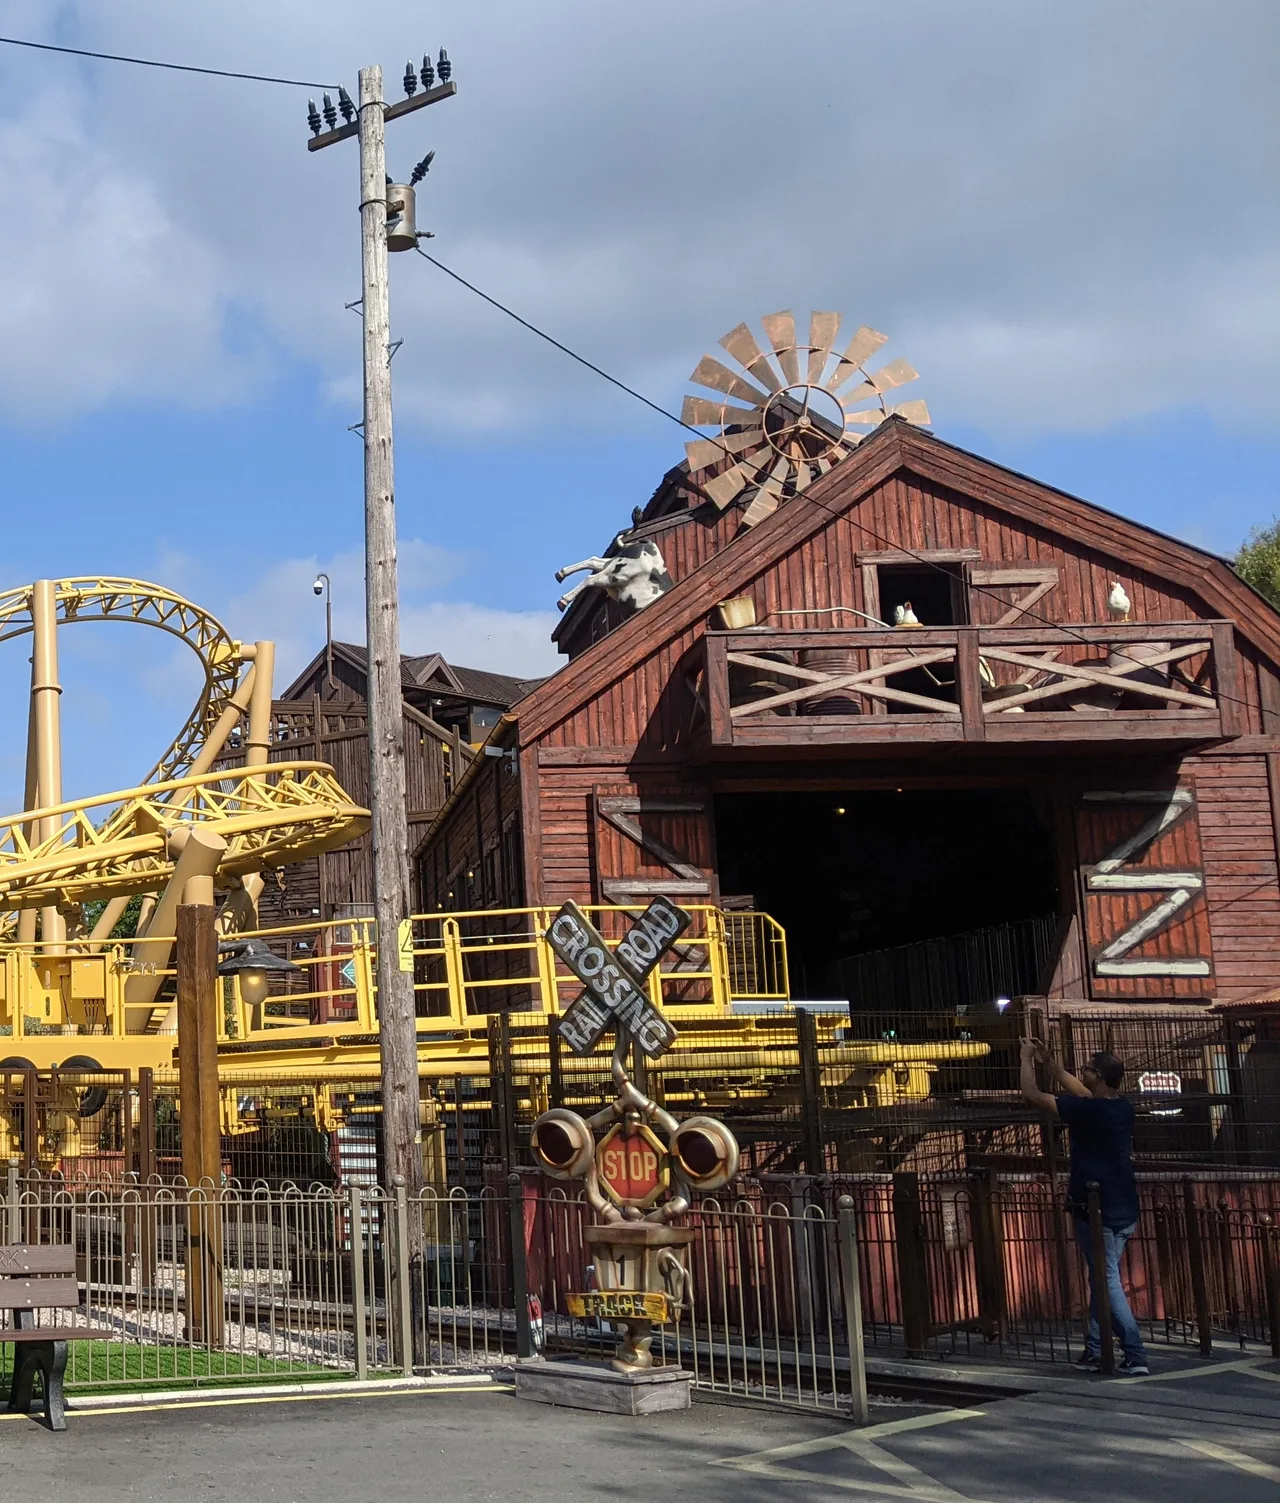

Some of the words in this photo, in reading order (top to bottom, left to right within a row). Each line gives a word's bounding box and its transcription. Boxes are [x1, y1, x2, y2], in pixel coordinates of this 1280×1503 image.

[552, 914, 668, 1052] CROSSING
[559, 995, 612, 1051] RAIL
[617, 903, 680, 974] ROAD
[604, 1150, 658, 1182] STOP
[616, 1254, 625, 1286] 1
[580, 1293, 648, 1317] TRACK
